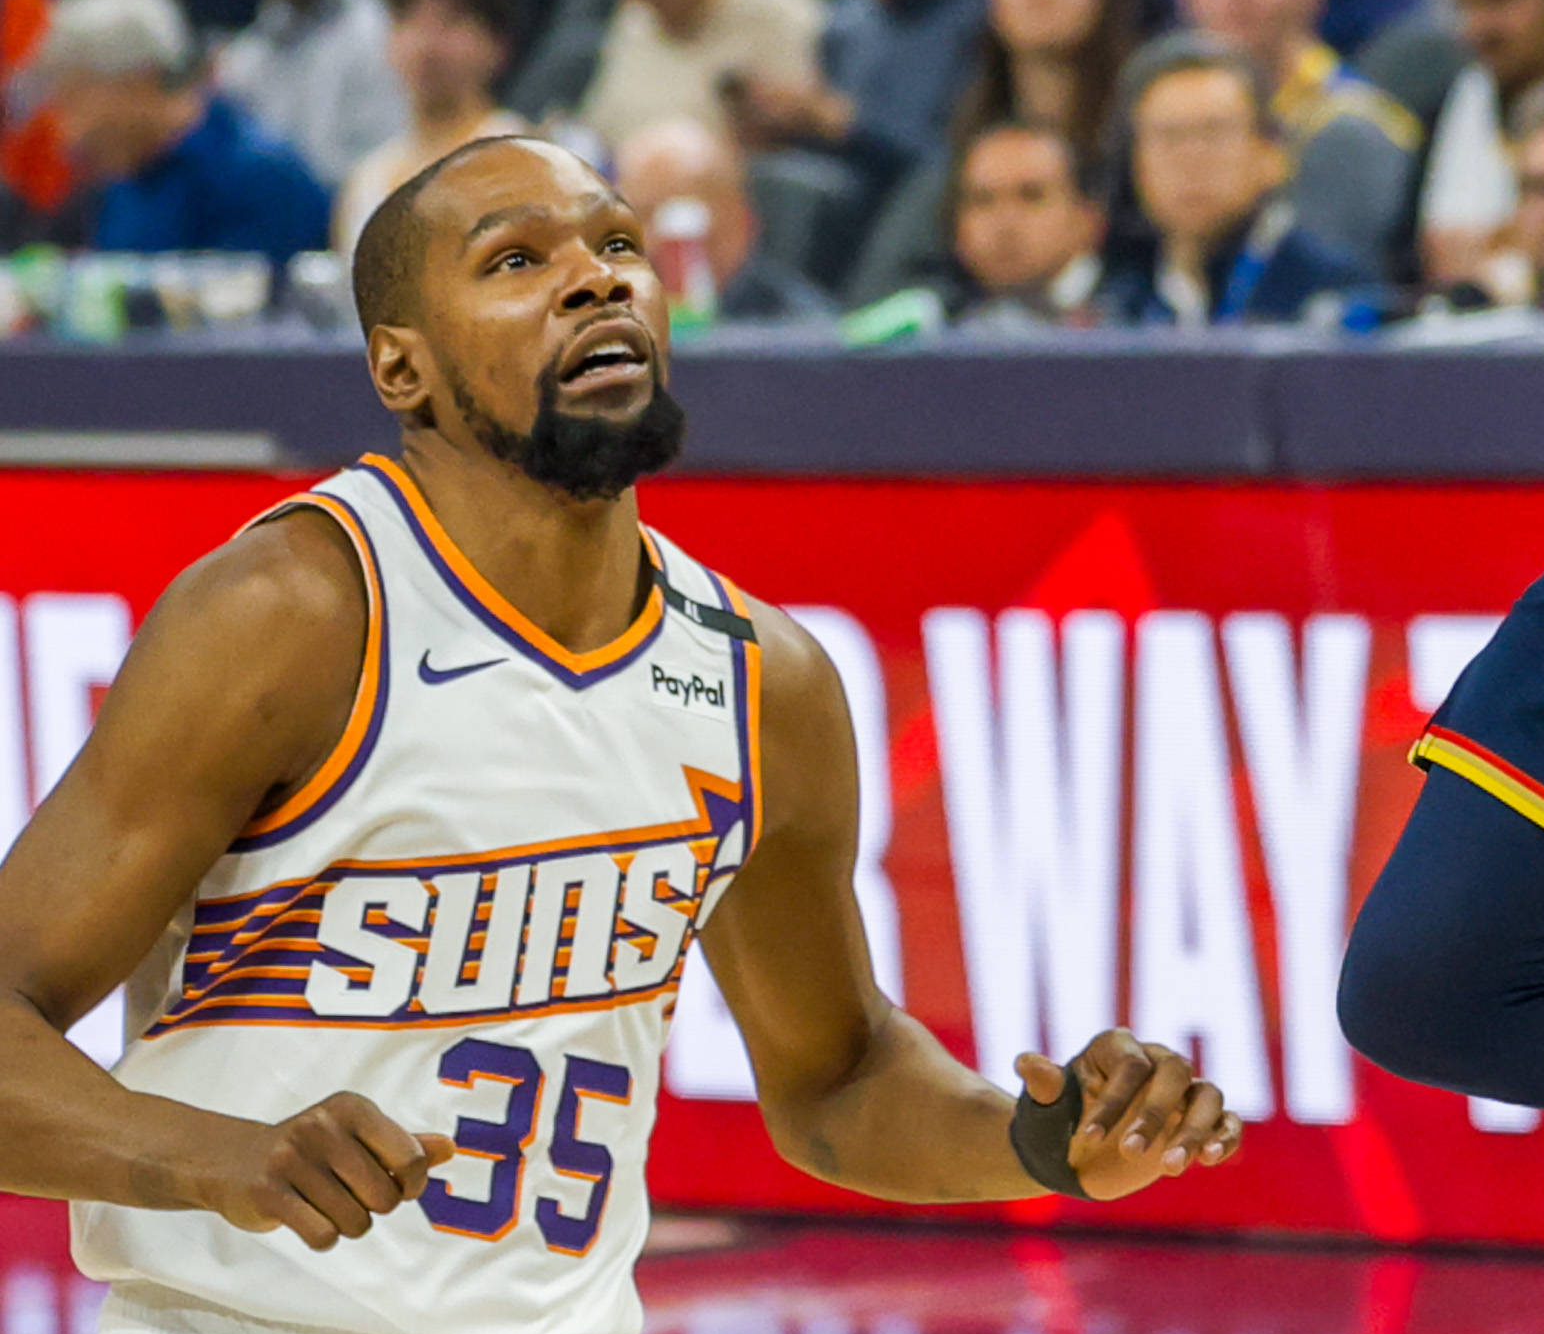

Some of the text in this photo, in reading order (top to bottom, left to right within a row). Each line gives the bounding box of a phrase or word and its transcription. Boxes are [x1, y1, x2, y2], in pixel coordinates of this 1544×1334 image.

[651, 664, 727, 709] PayPal
[921, 605, 1371, 1127] WAY
[415, 1037, 632, 1259] 35
